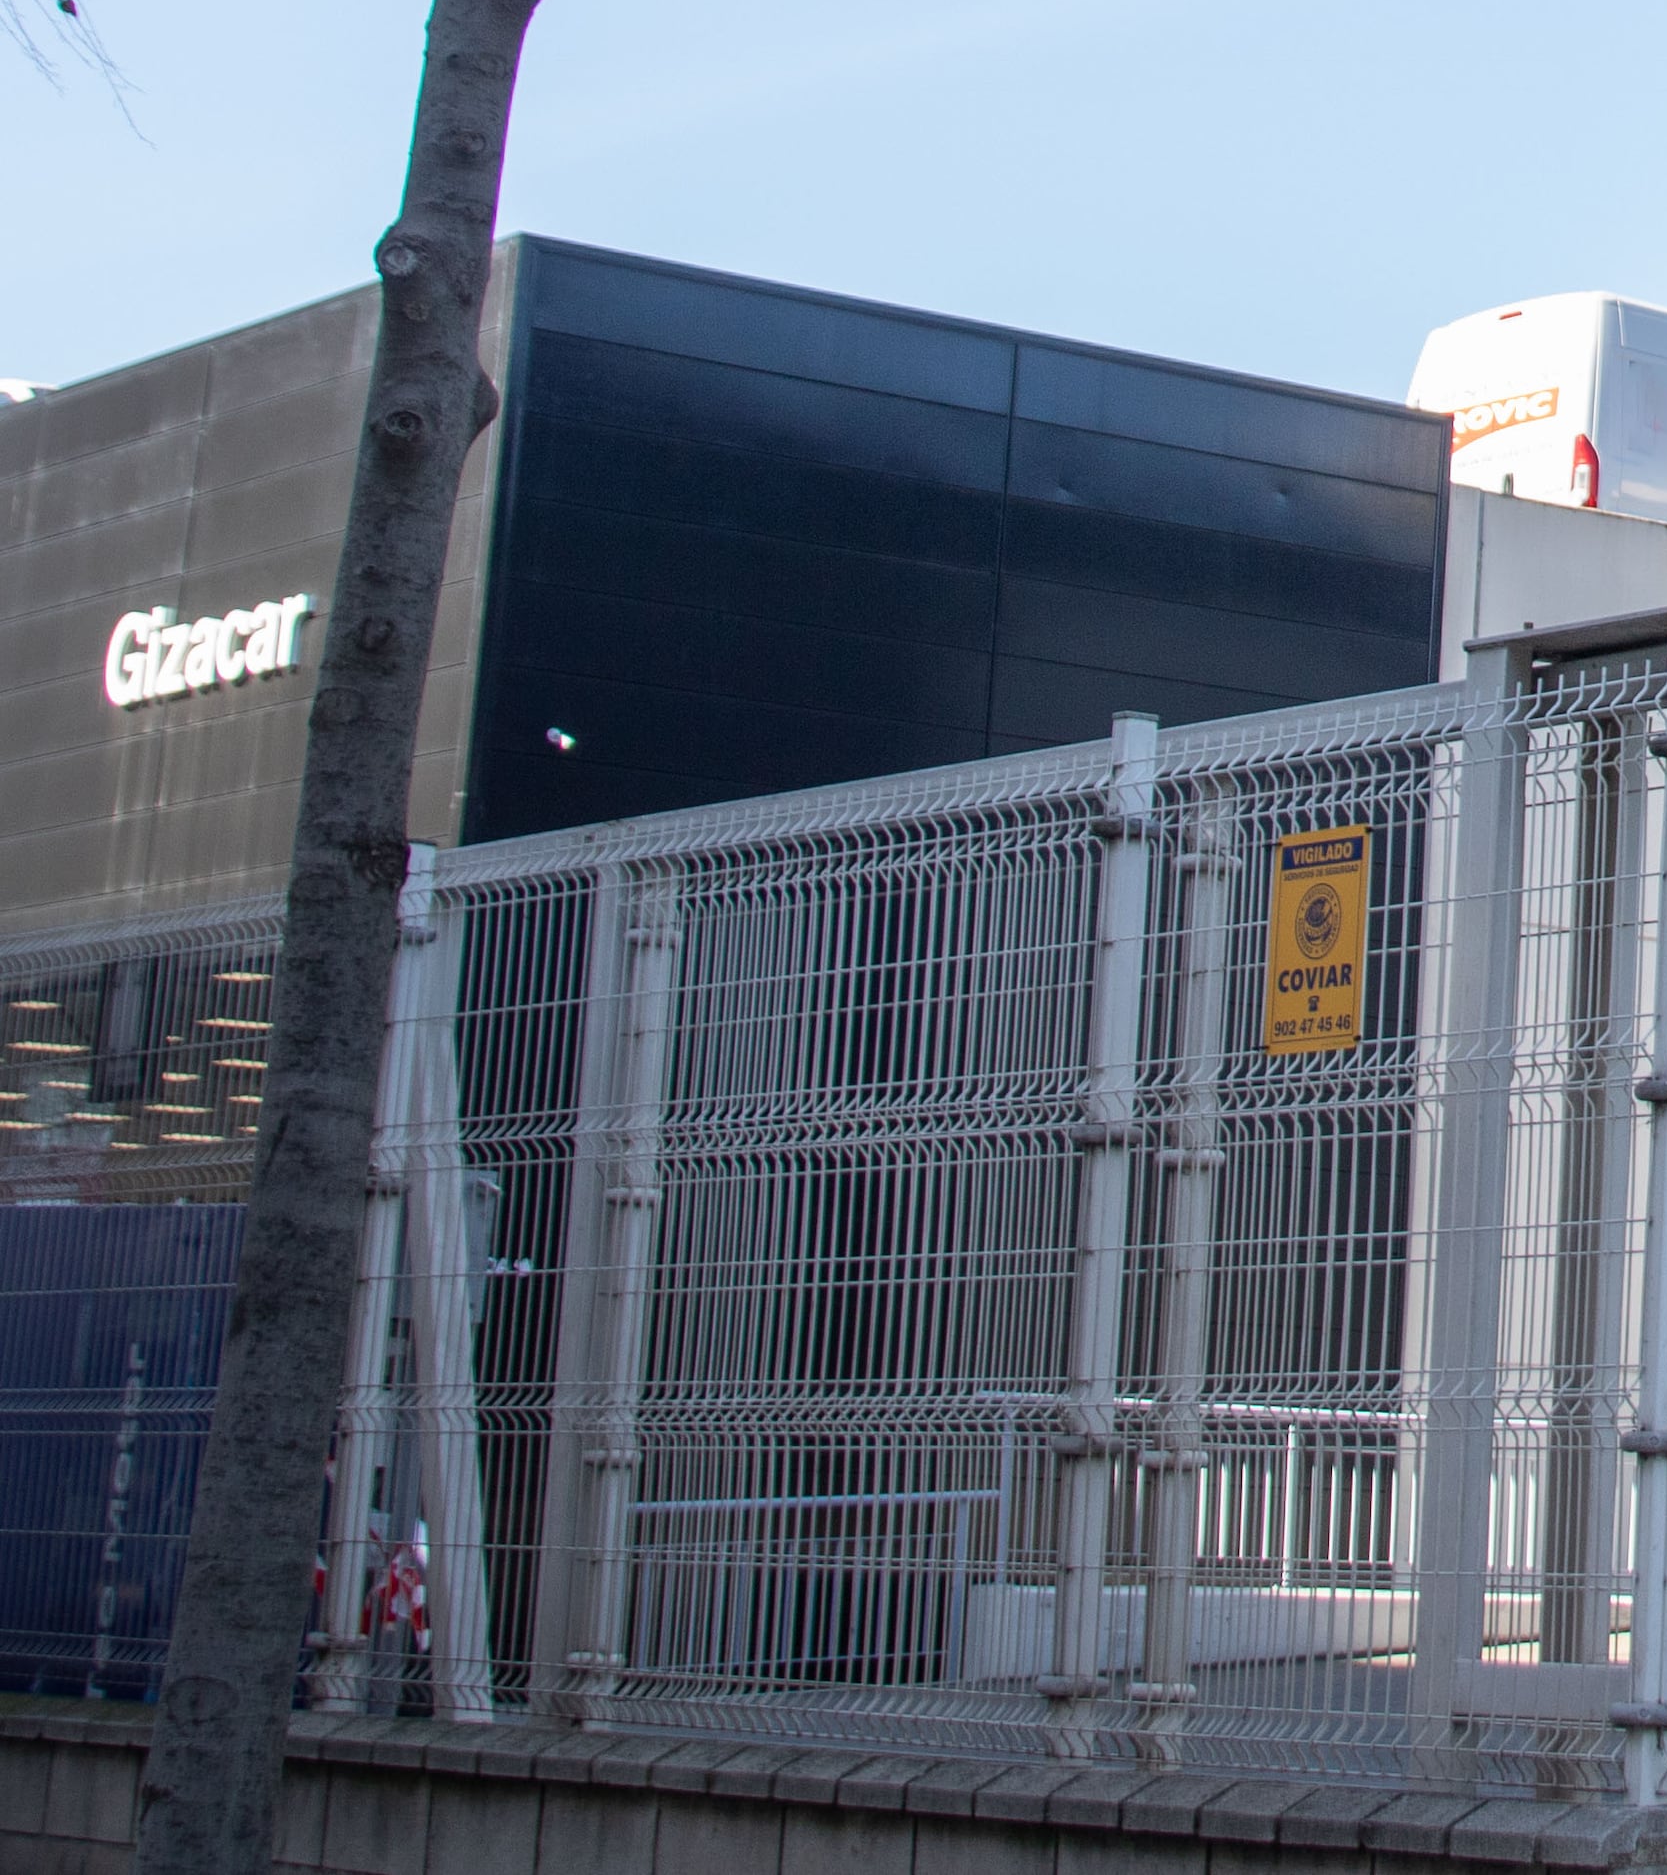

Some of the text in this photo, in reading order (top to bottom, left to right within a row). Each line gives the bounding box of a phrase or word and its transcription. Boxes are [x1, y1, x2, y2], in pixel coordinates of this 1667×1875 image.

[104, 593, 312, 707] Gizacar
[1292, 842, 1353, 865] VIGILADO
[1278, 964, 1352, 993] COVIAR
[1274, 1014, 1351, 1037] 902 47 45 46
